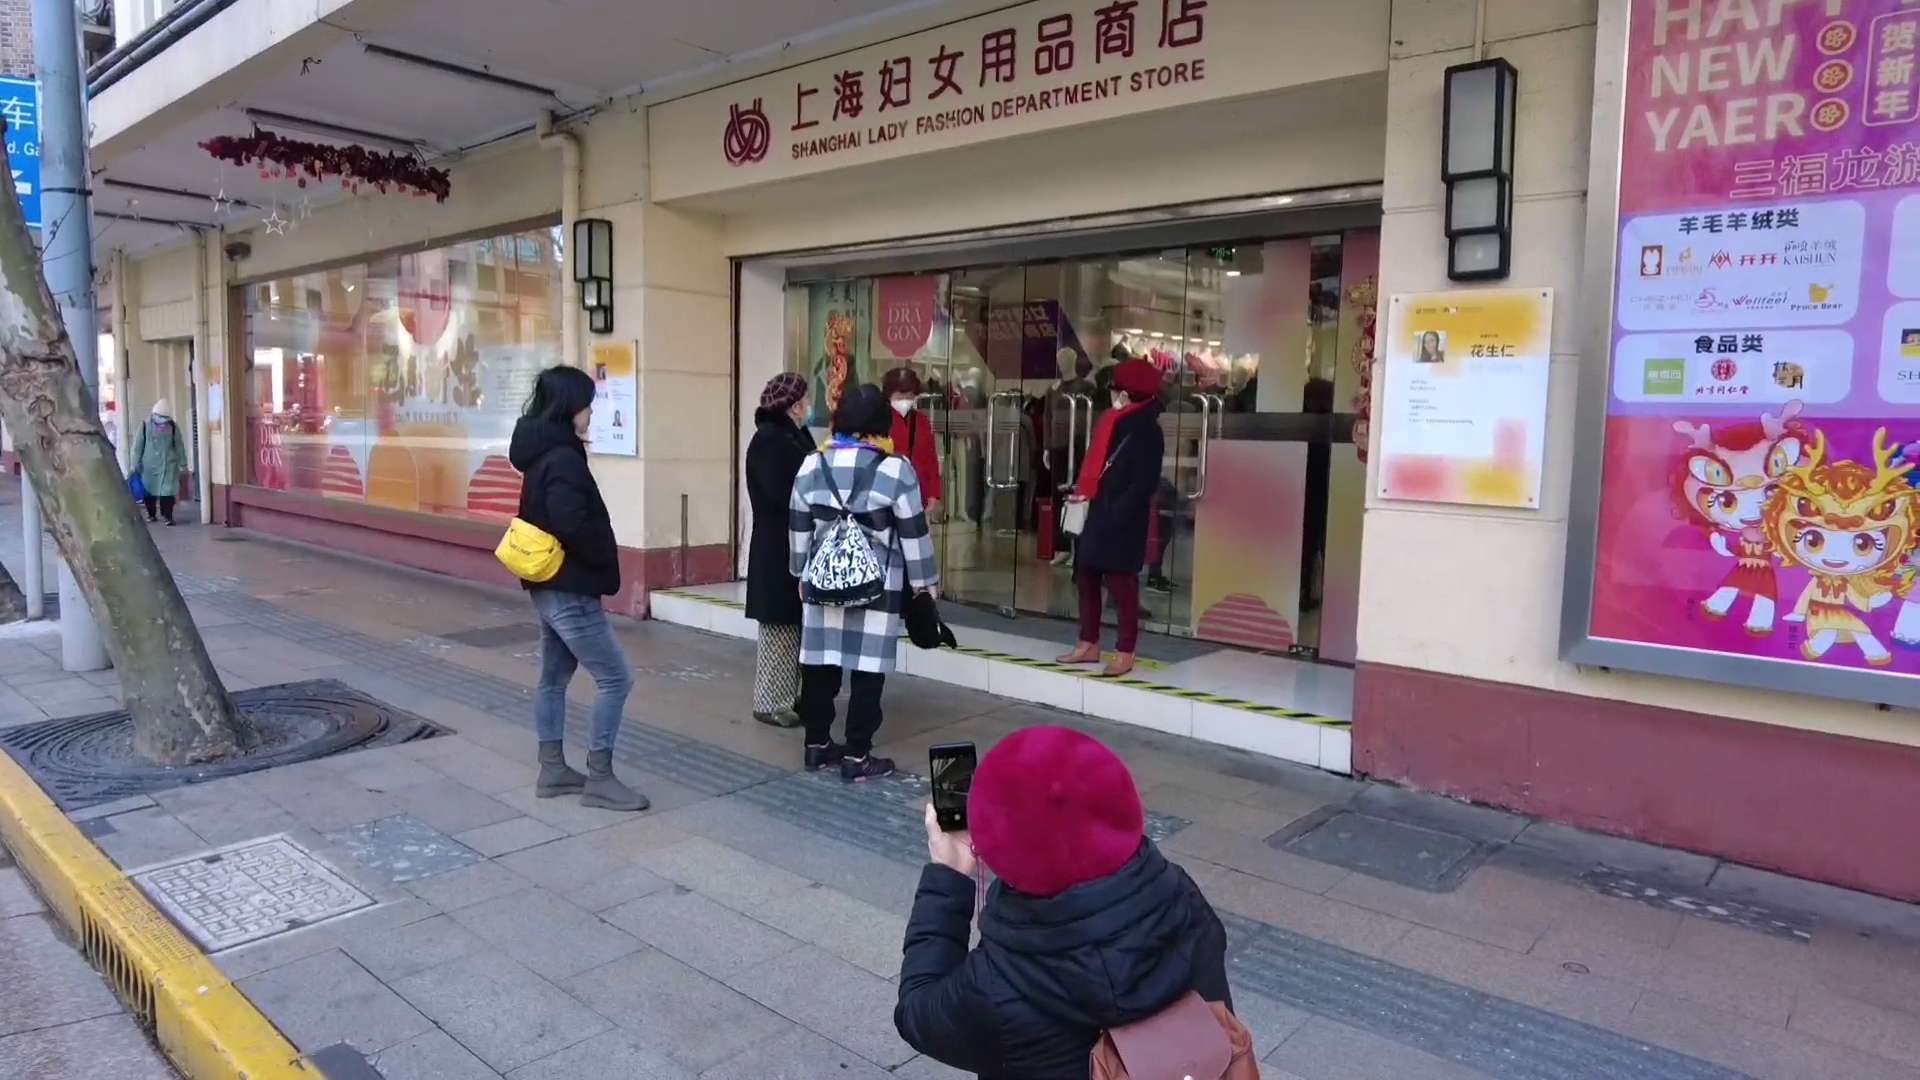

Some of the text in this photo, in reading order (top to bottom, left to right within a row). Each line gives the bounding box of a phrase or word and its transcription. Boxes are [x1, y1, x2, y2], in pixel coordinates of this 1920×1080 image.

[791, 0, 1208, 132] 上海妇女用品商店
[1651, 34, 1797, 98] NEW
[1872, 21, 1917, 119] 贺新年
[791, 58, 1206, 160] SHANGHAI LADY FASHION DEPARTMENT STORE
[1645, 92, 1807, 152] YAER
[6, 141, 20, 154] d.
[1678, 208, 1800, 235] 羊毛羊绒类
[888, 306, 921, 324] DRA
[887, 324, 921, 343] GON
[1694, 334, 1764, 354] 食品类
[1470, 343, 1516, 358] 花生仁
